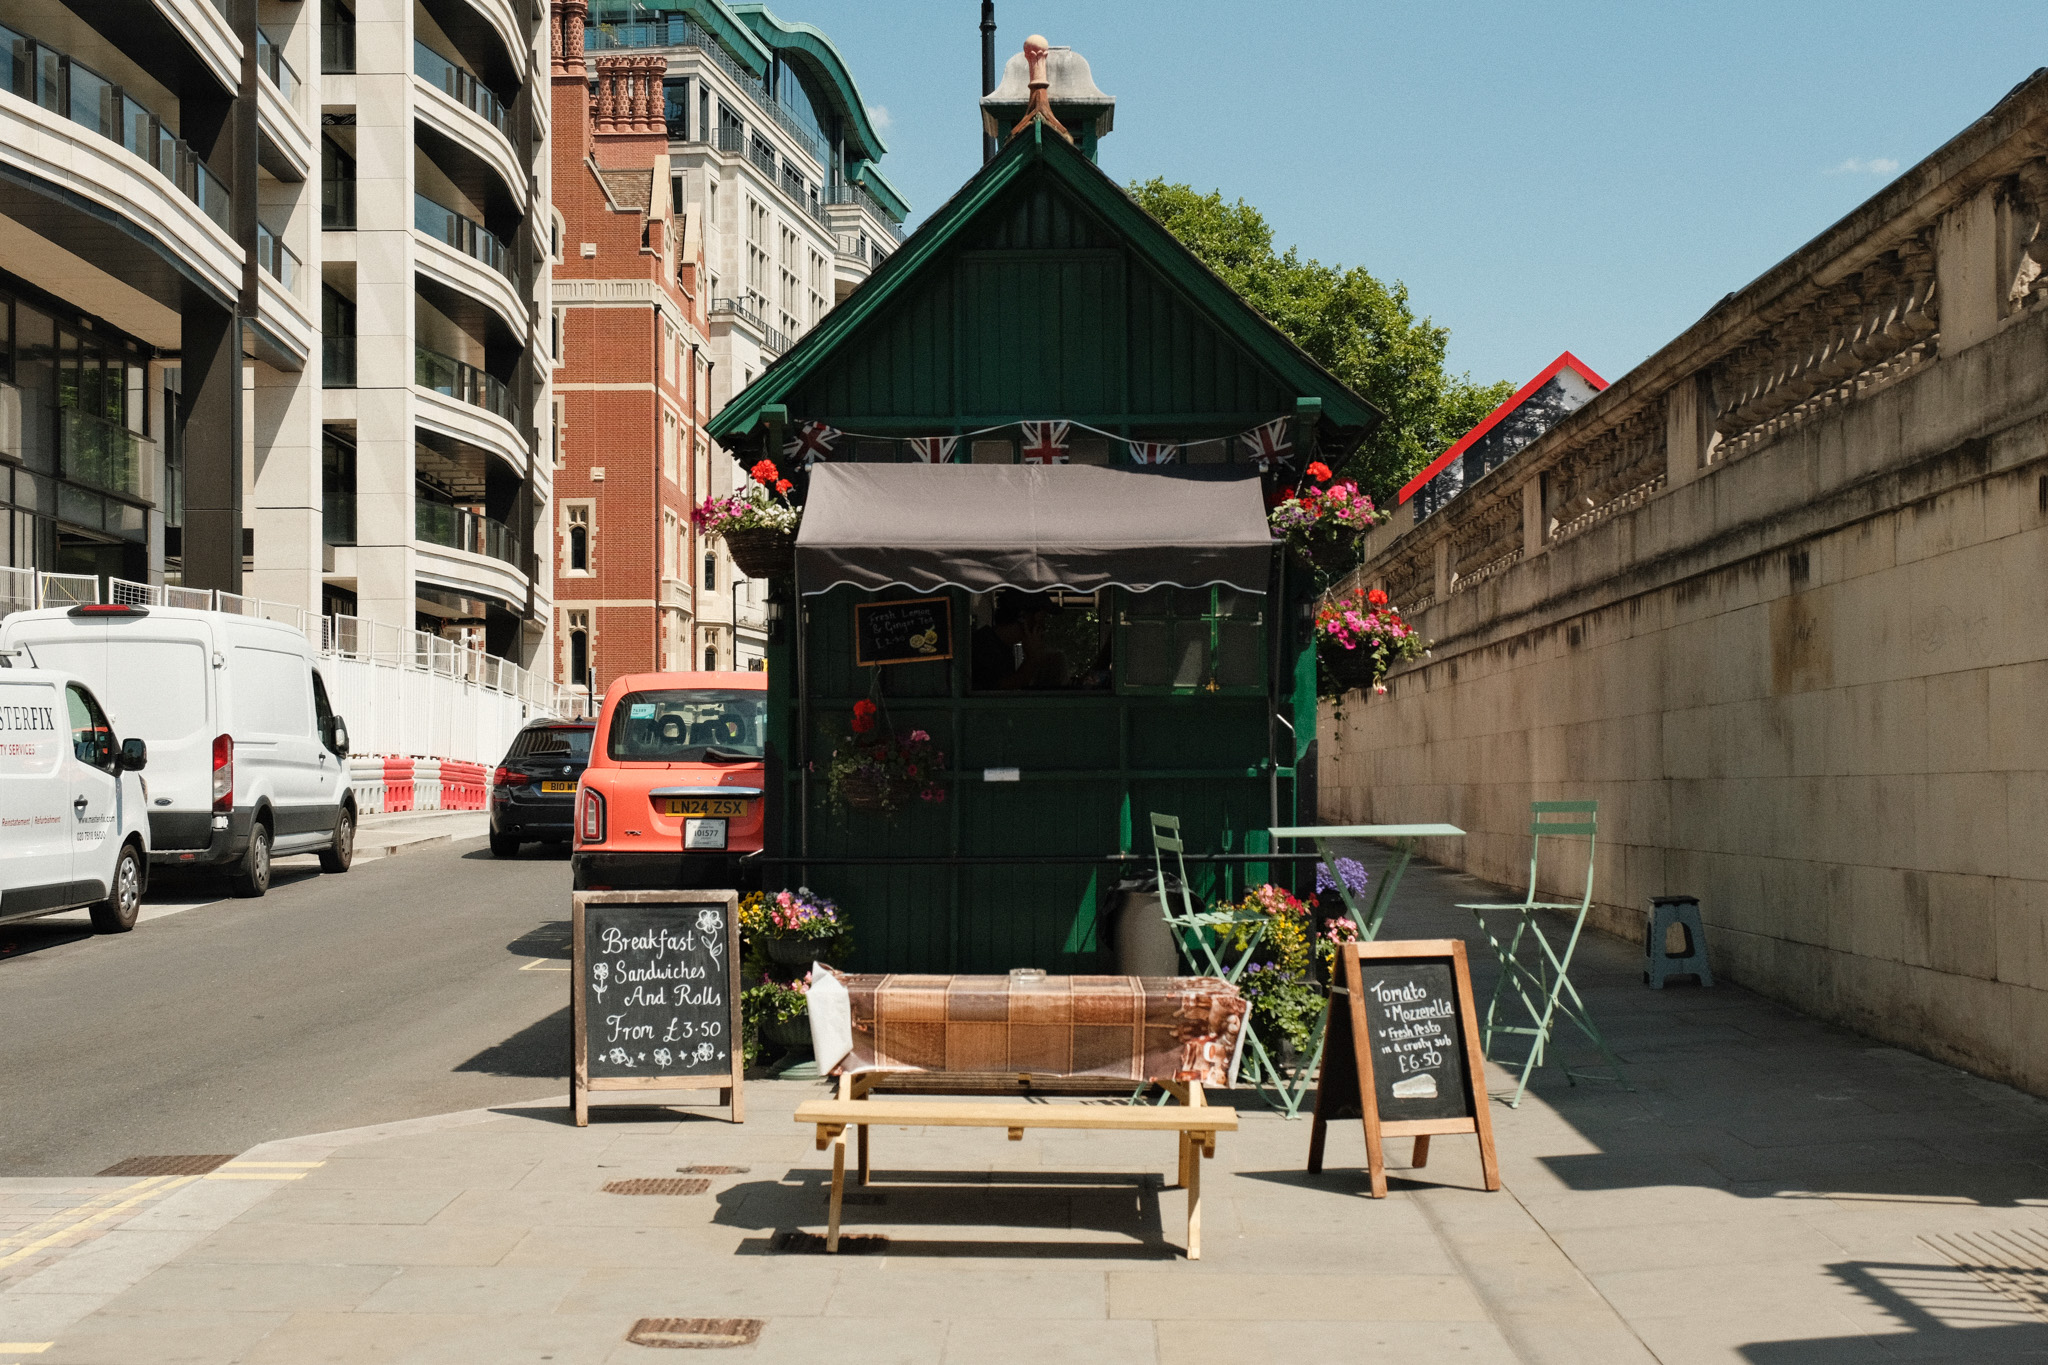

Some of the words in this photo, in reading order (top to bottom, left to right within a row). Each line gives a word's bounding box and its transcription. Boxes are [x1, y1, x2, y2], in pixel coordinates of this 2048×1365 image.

[868, 610, 896, 625] Fresh
[901, 608, 931, 618] Lemon
[872, 624, 881, 634] &
[885, 620, 915, 634] Ginger
[9, 744, 35, 755] SERVICES
[671, 799, 709, 814] LN24
[713, 799, 741, 815] ZSX
[694, 829, 719, 837] 101577
[601, 927, 696, 960] Breakfast
[614, 960, 706, 985] Sandwiches
[624, 985, 667, 1007] And
[673, 984, 722, 1007] Rolls
[1370, 980, 1427, 1003] Tomato
[606, 1012, 655, 1043] From
[1388, 1023, 1414, 1039] Fresh
[1413, 1020, 1442, 1036] Pesto
[1381, 1045, 1392, 1054] in
[1403, 1037, 1433, 1054] crusty
[1434, 1034, 1452, 1047] sub
